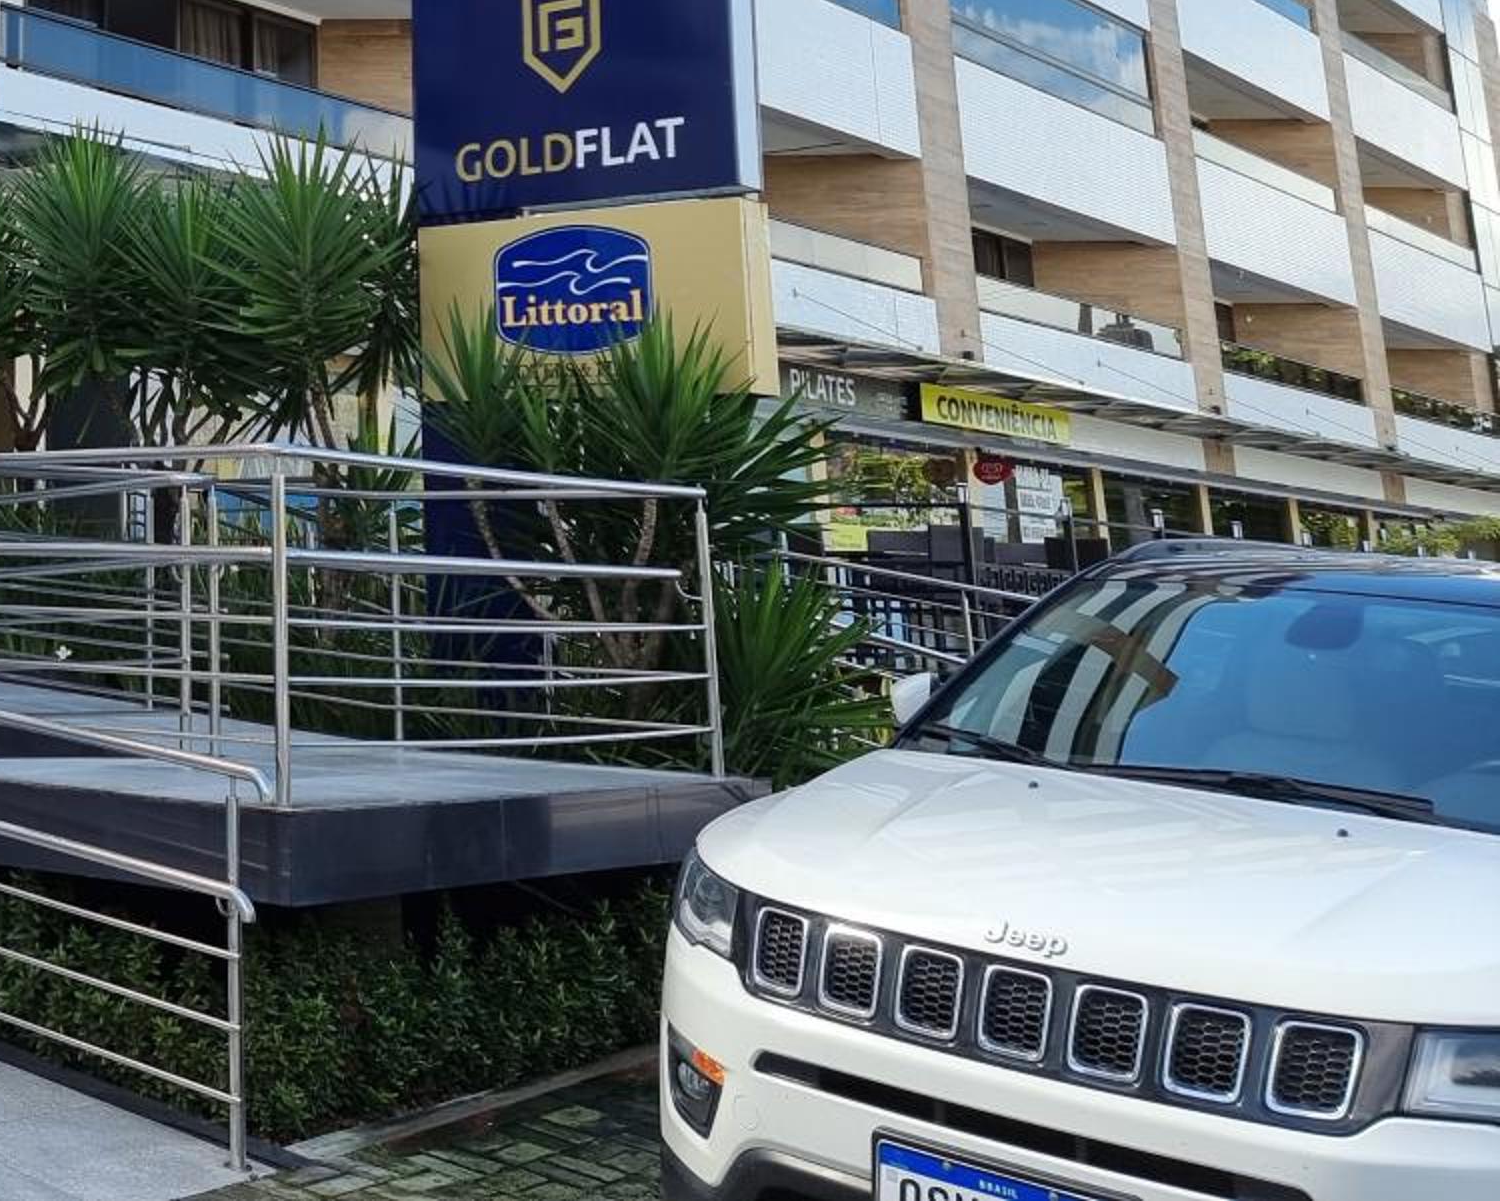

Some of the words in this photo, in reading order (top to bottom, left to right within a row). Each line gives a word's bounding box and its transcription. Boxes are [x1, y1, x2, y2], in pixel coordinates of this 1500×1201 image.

[456, 117, 685, 182] GOLDFLAT
[502, 289, 643, 327] Littoral
[789, 368, 855, 406] PILATES
[937, 395, 1057, 440] CONVENIÊNCIA
[983, 918, 1069, 959] Jeep
[978, 1179, 1019, 1200] BRASIL
